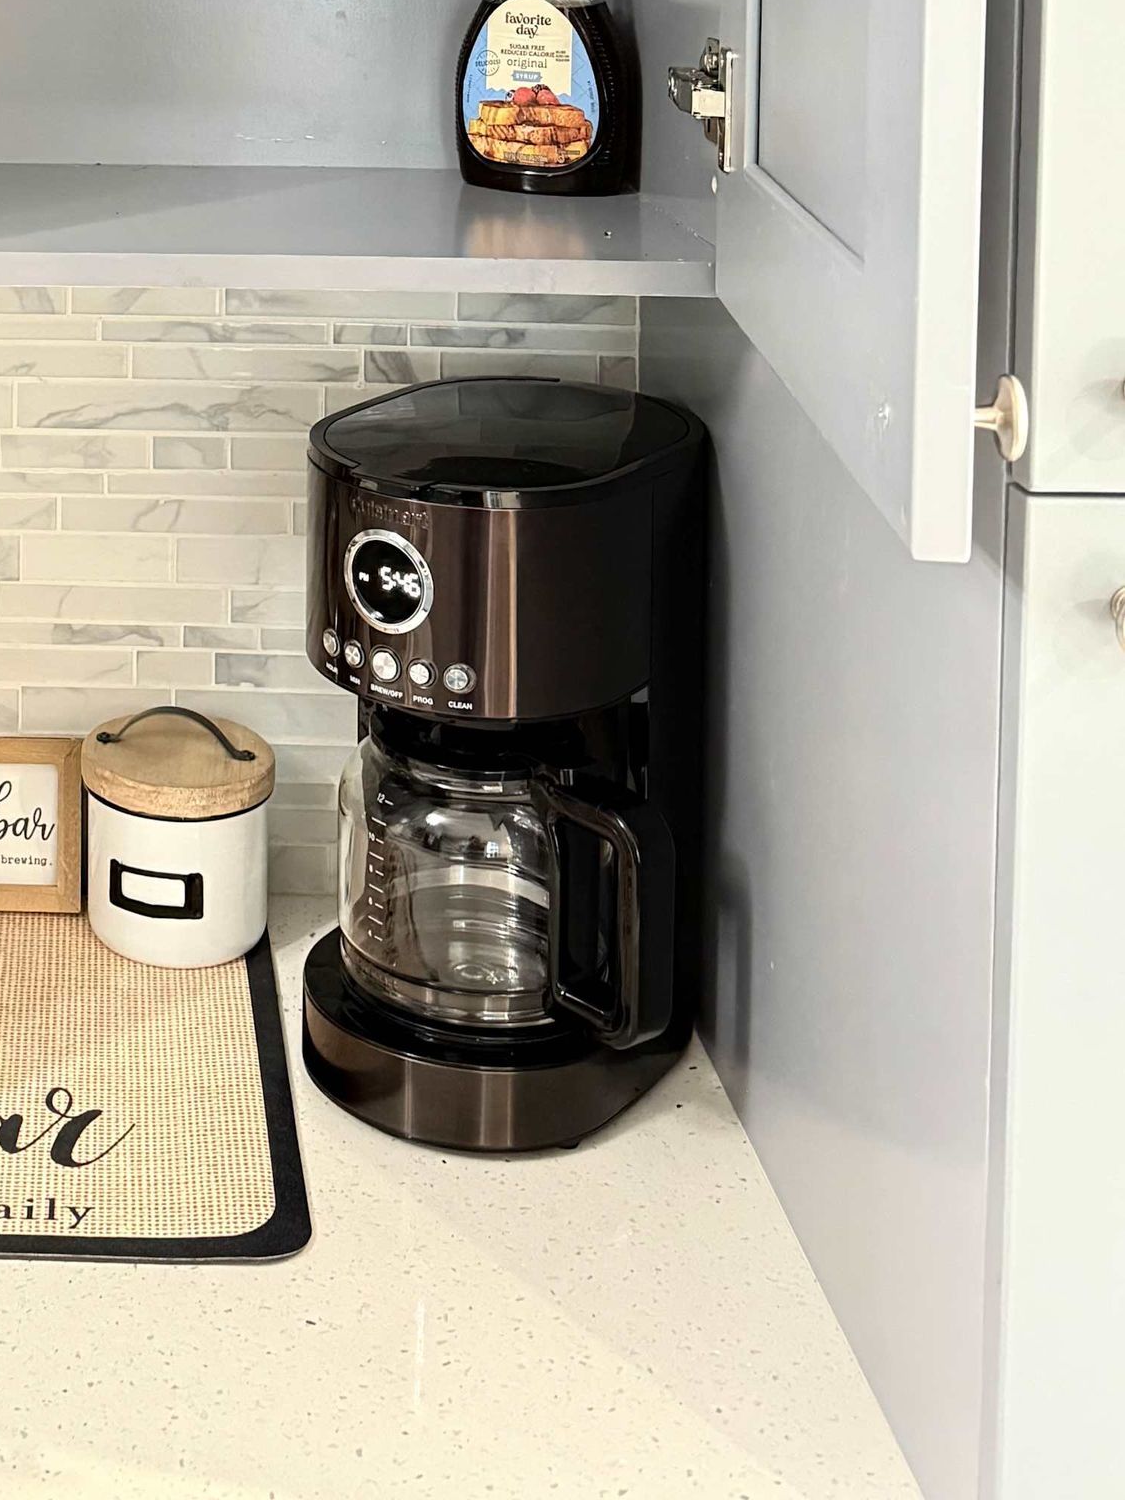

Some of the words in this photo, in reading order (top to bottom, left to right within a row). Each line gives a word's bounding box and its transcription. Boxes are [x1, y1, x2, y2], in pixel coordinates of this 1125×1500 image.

[505, 11, 552, 26] favorite
[515, 24, 539, 39] day
[500, 49, 528, 57] REDUCED
[506, 58, 548, 69] original
[380, 566, 421, 599] 5:46
[370, 683, 403, 699] BREW/OFF
[412, 694, 434, 705] PROG
[448, 700, 473, 710] CLEAN
[0, 854, 54, 866] brewing.
